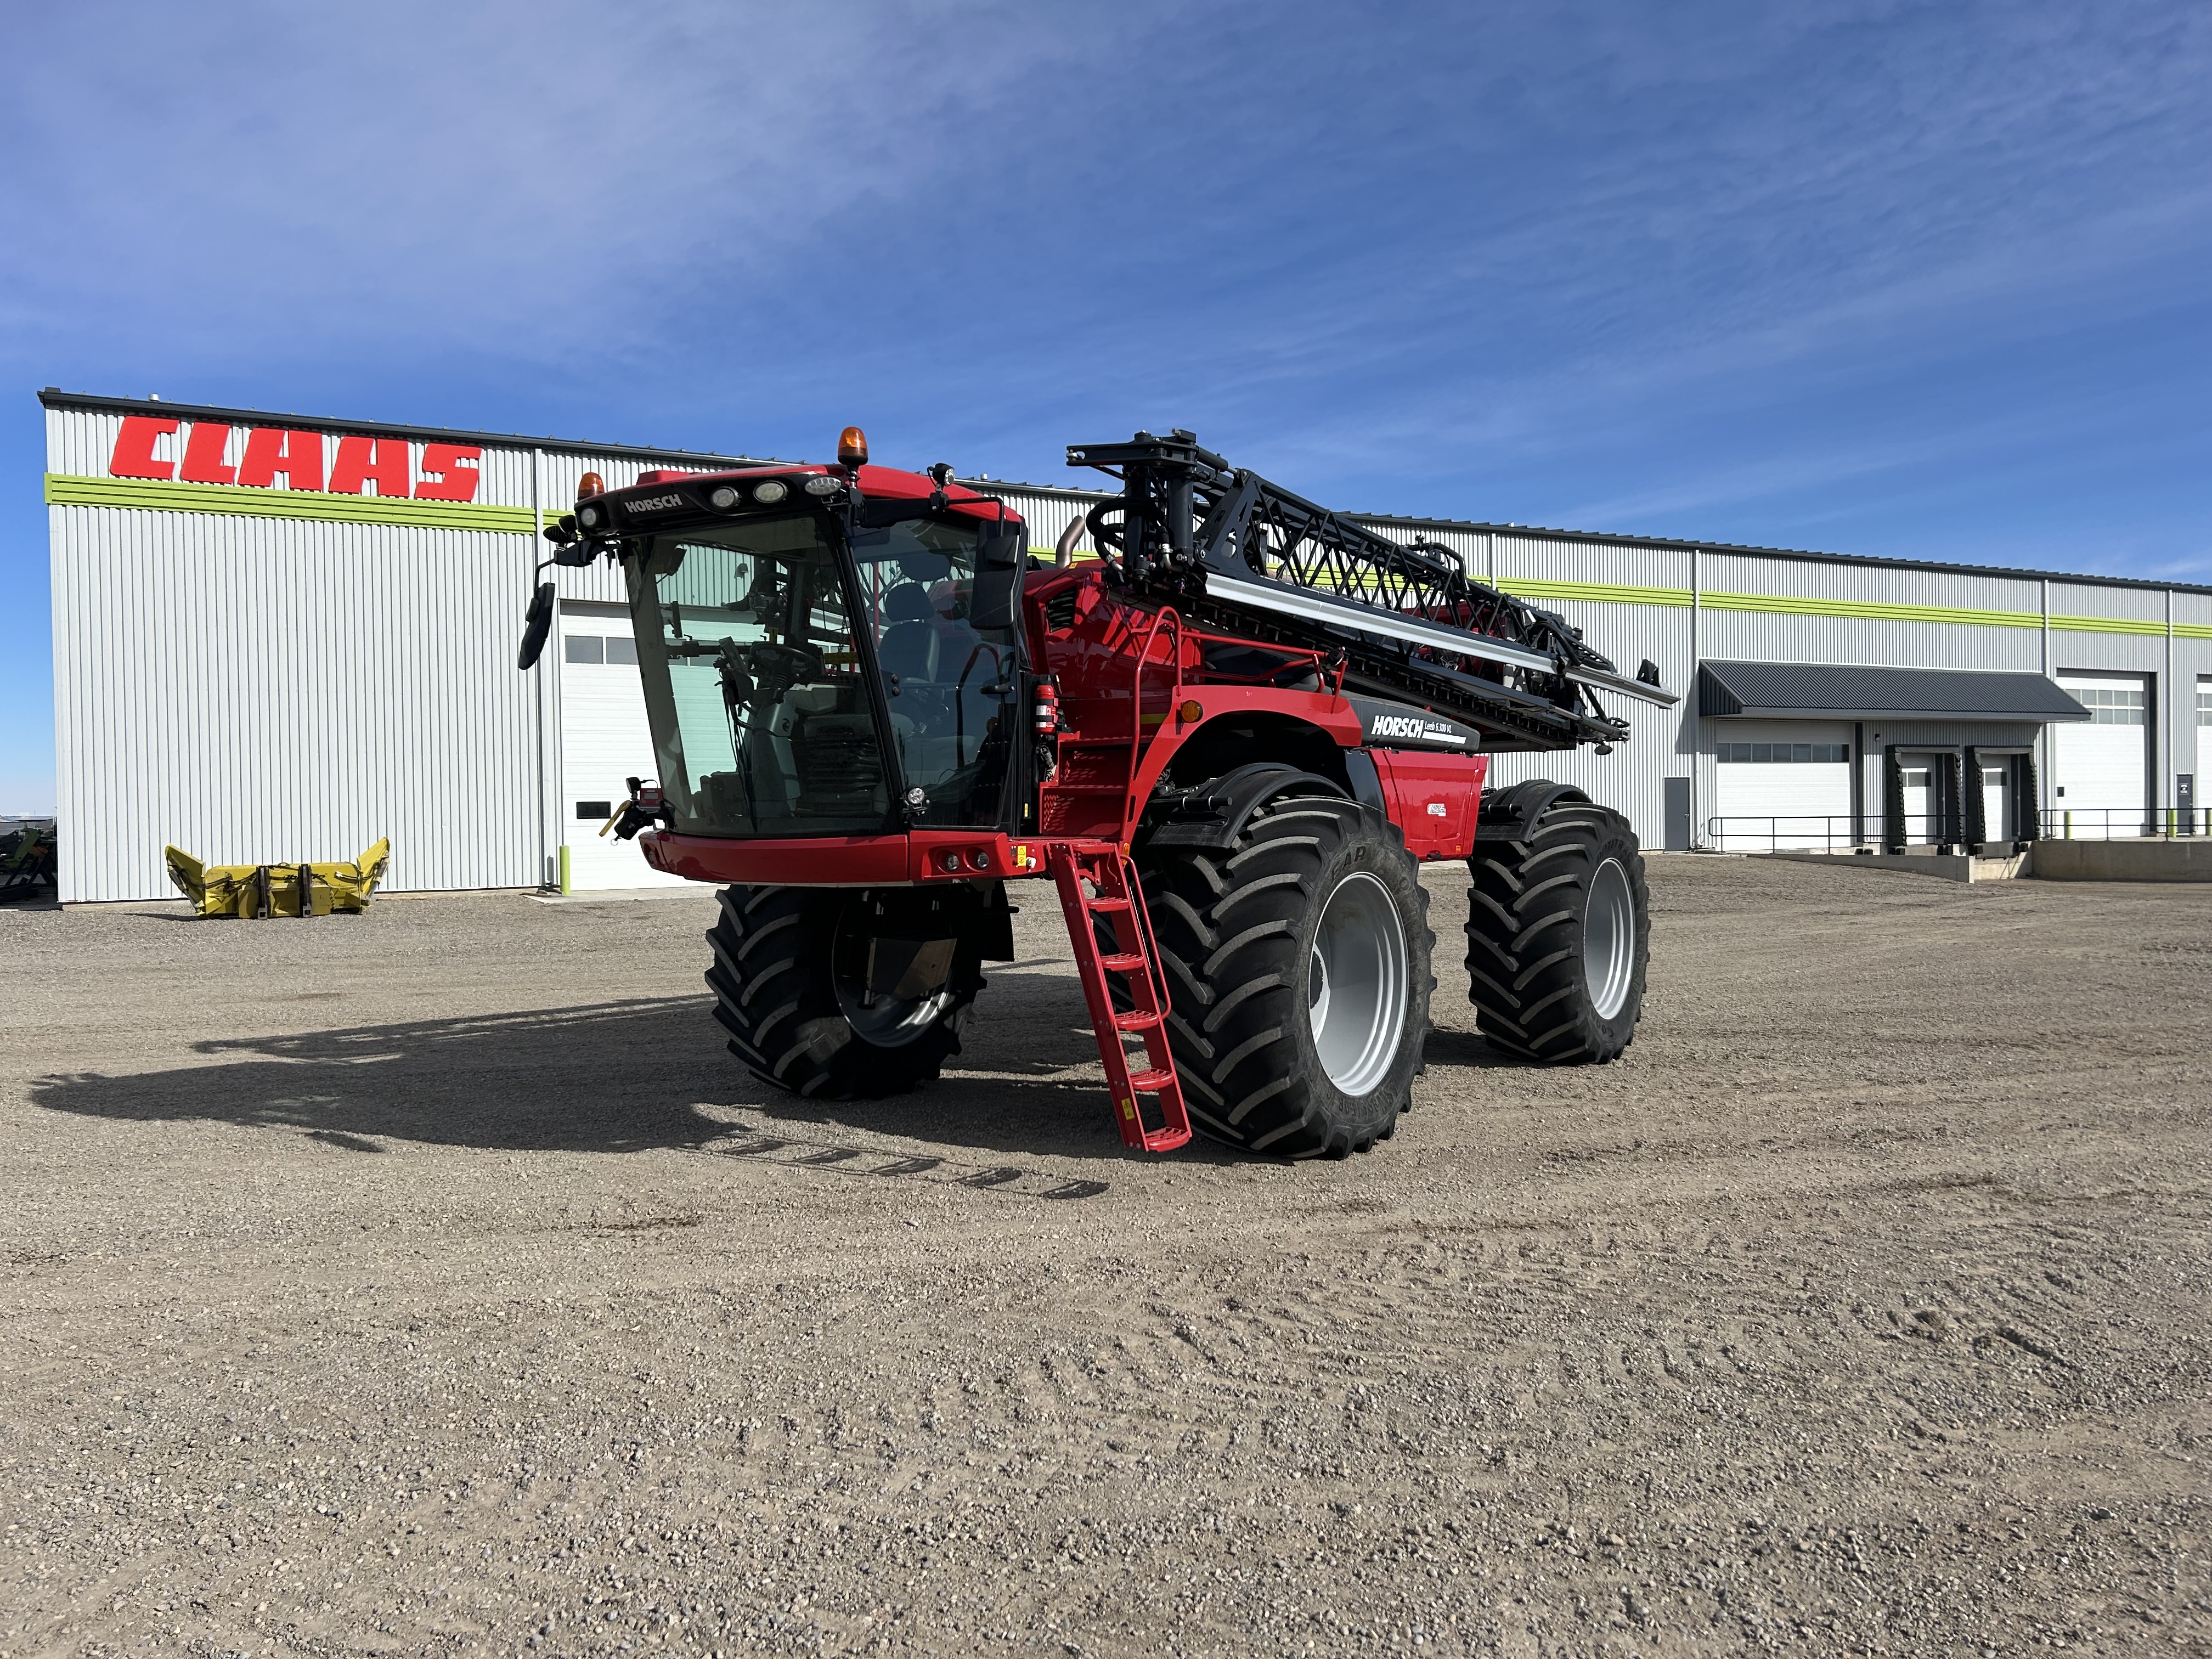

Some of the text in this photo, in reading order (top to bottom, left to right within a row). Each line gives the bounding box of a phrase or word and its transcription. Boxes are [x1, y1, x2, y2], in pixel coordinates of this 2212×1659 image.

[110, 415, 483, 501] CLAAS
[624, 494, 683, 513] HORSCH
[1371, 715, 1424, 738] HORSCH
[1424, 721, 1435, 731] Leeb
[1435, 722, 1447, 732] 6.300
